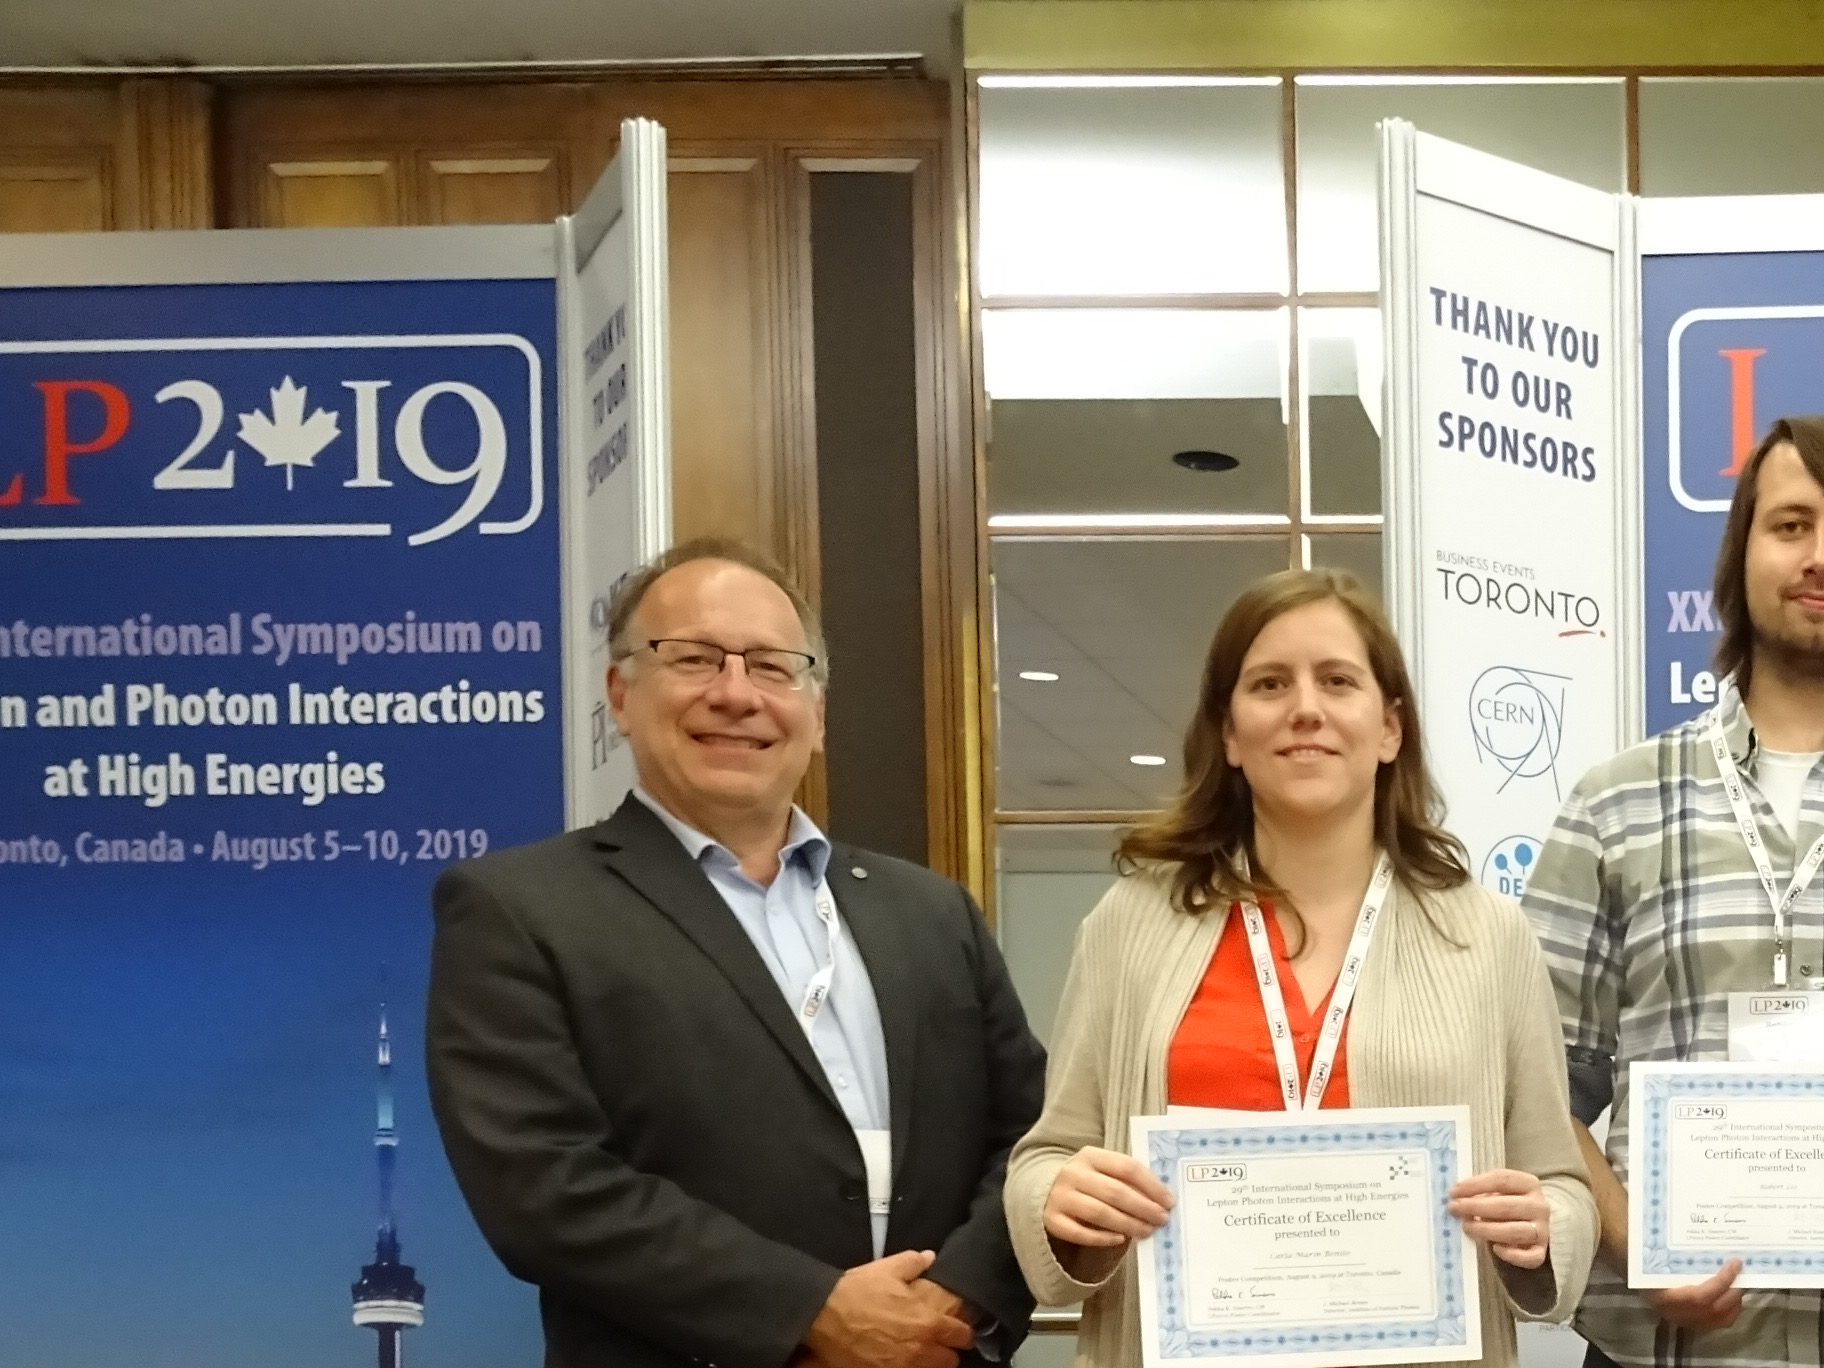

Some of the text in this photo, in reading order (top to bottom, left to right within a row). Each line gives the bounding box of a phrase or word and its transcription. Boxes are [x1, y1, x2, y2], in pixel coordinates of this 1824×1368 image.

[1430, 286, 1599, 369] THANK YOU
[1461, 355, 1573, 421] TO OUR
[1438, 411, 1597, 483] SPONSORS
[1436, 549, 1536, 580] BUSINESS EVENTS
[1436, 568, 1600, 627] TORONTO
[250, 610, 481, 666] Symposium
[492, 619, 543, 653] on
[36, 684, 117, 727] and
[127, 684, 278, 728] Photon
[288, 679, 545, 726] Interactions
[1477, 698, 1535, 726] CERN
[44, 751, 386, 807] at High Energies
[75, 832, 184, 862] Canada
[211, 830, 315, 870] August
[415, 828, 488, 859] 2019
[1704, 1148, 1766, 1160] Certificate
[1769, 1148, 1782, 1160] of
[1748, 1164, 1806, 1173] presented to
[1207, 1198, 1238, 1208] Lepton
[1242, 1196, 1275, 1206] Photon
[1277, 1195, 1331, 1205] Interactions
[1346, 1192, 1367, 1202] High
[1370, 1190, 1409, 1201] Energies
[1223, 1208, 1387, 1227] Certificate of Excellence
[1275, 1227, 1341, 1240] presented to
